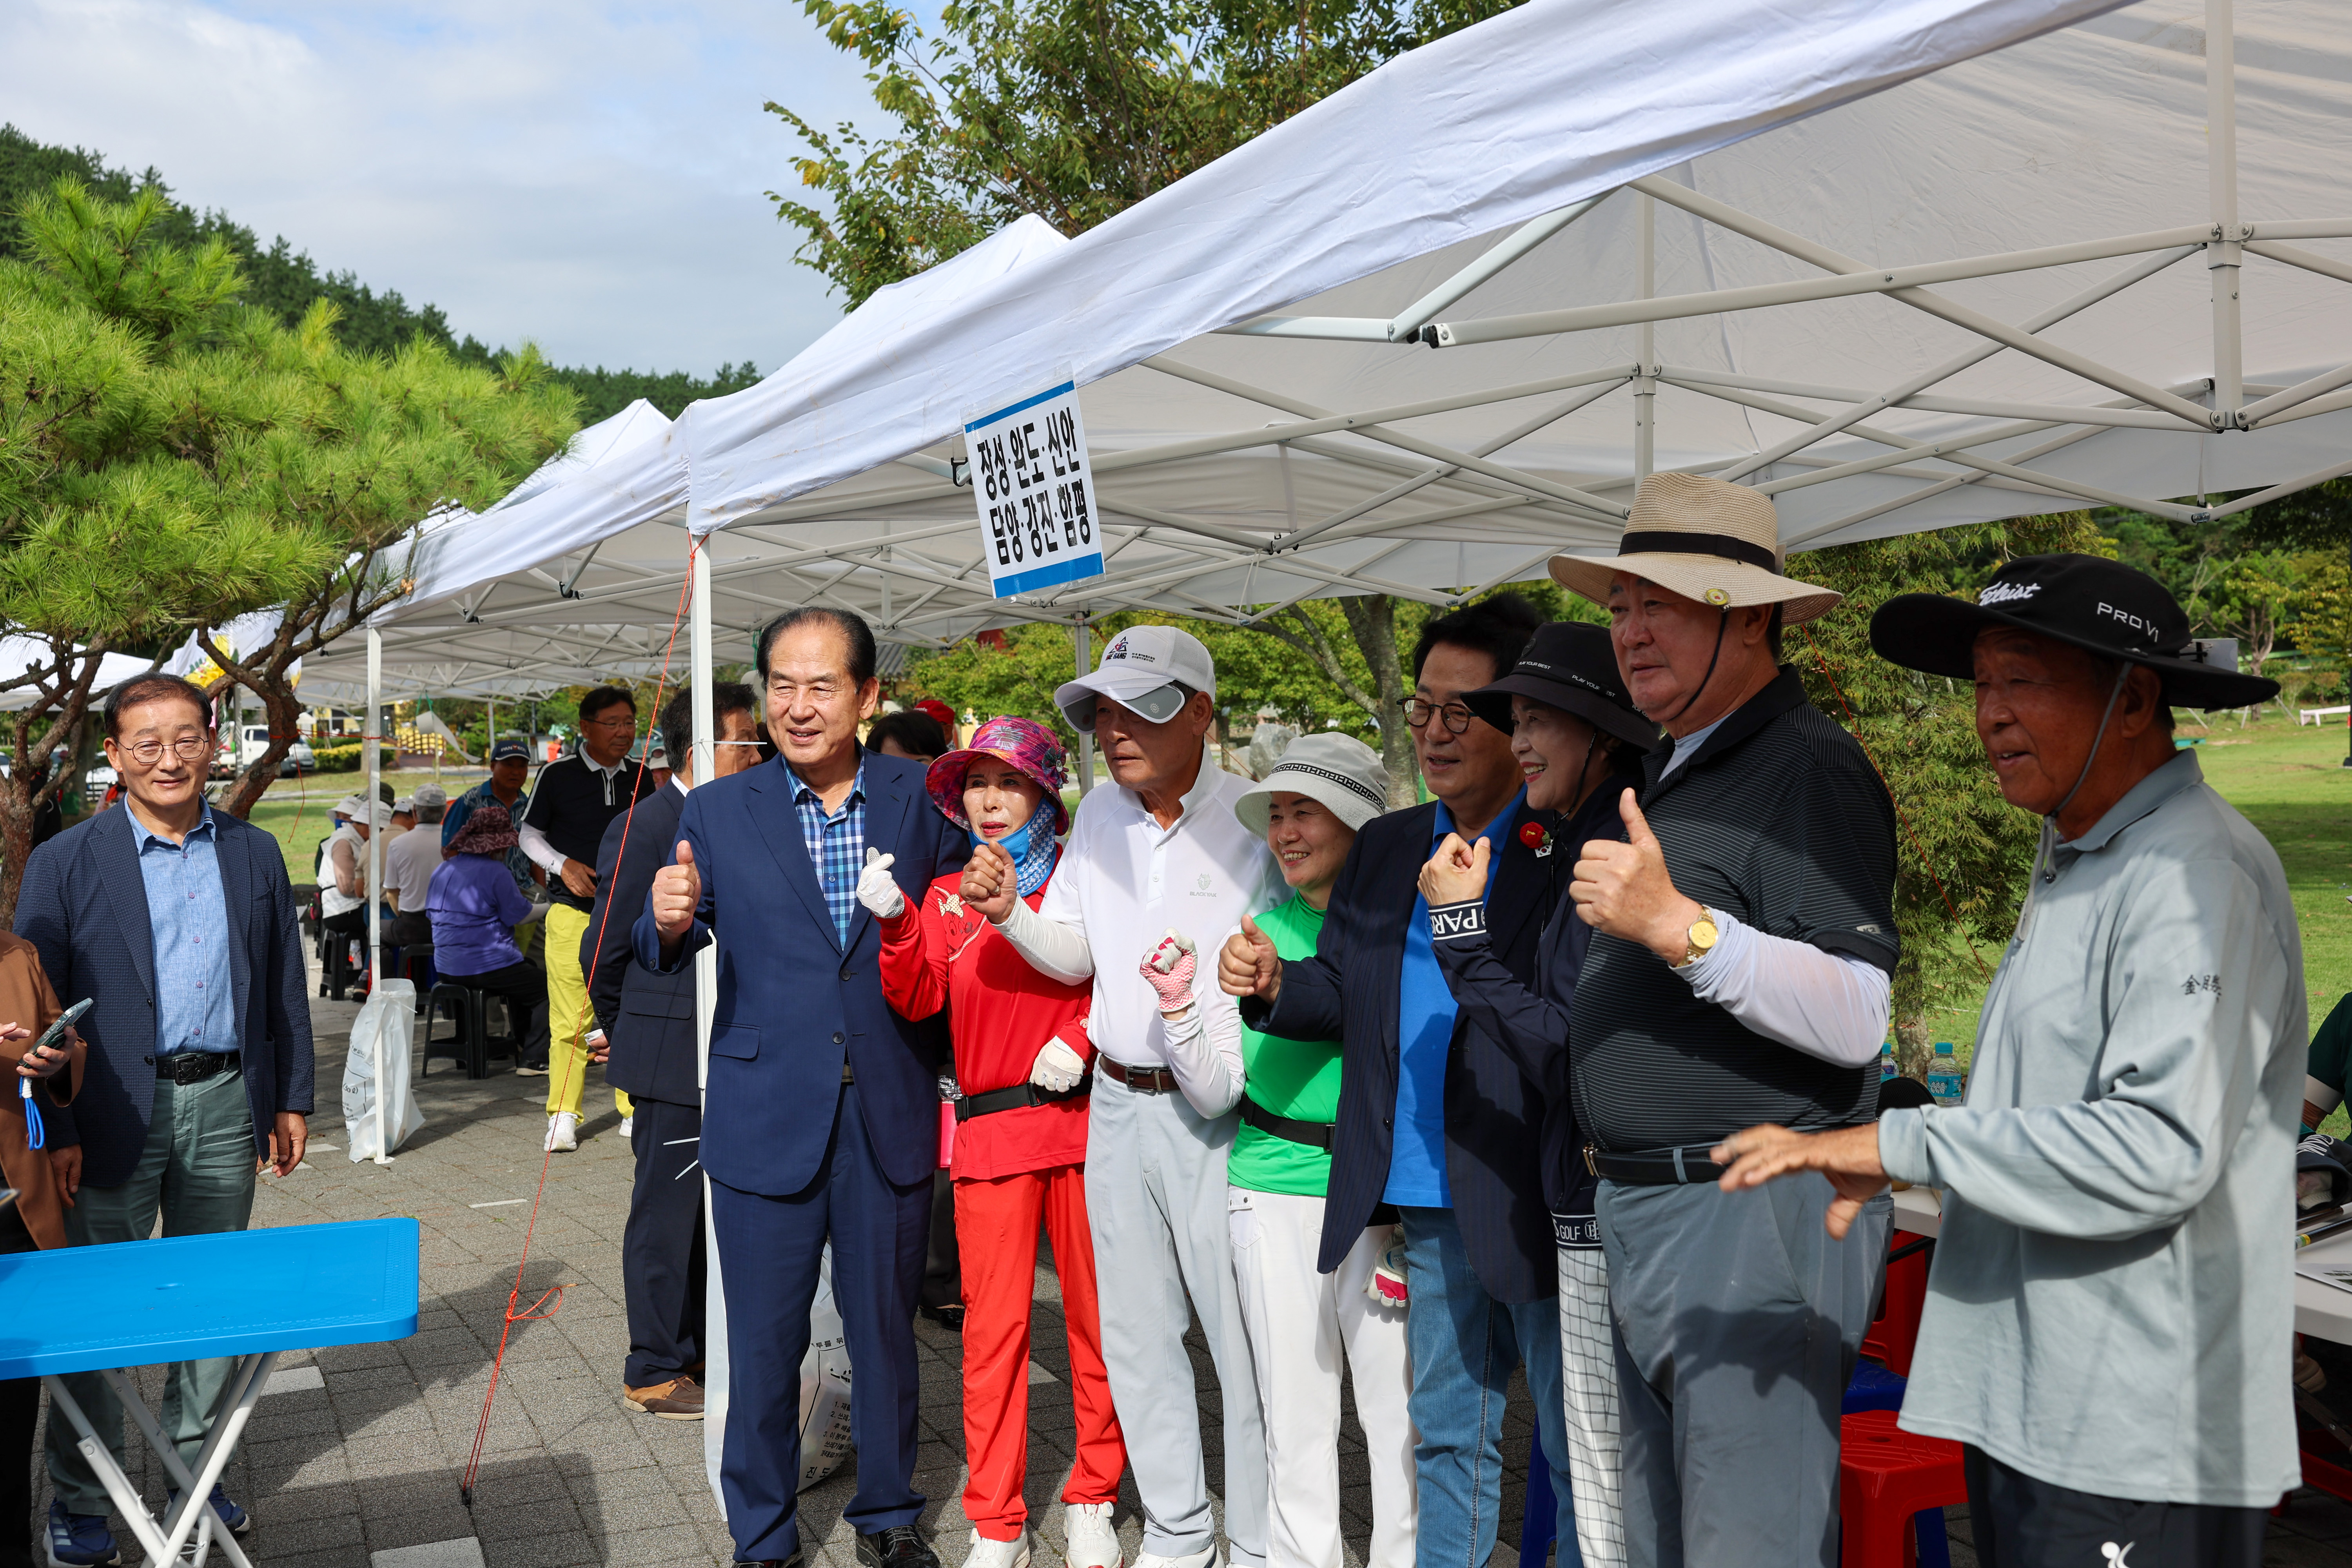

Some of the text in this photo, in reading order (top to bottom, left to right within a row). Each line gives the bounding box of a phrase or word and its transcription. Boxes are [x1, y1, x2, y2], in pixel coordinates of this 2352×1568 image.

[2097, 602, 2142, 629] PRO
[1572, 675, 1586, 683] PLAY
[1559, 1225, 1581, 1241] GOLF
[811, 1340, 832, 1349] 투를
[835, 1433, 847, 1441] 봉투
[824, 1441, 844, 1450] 쓰레기를
